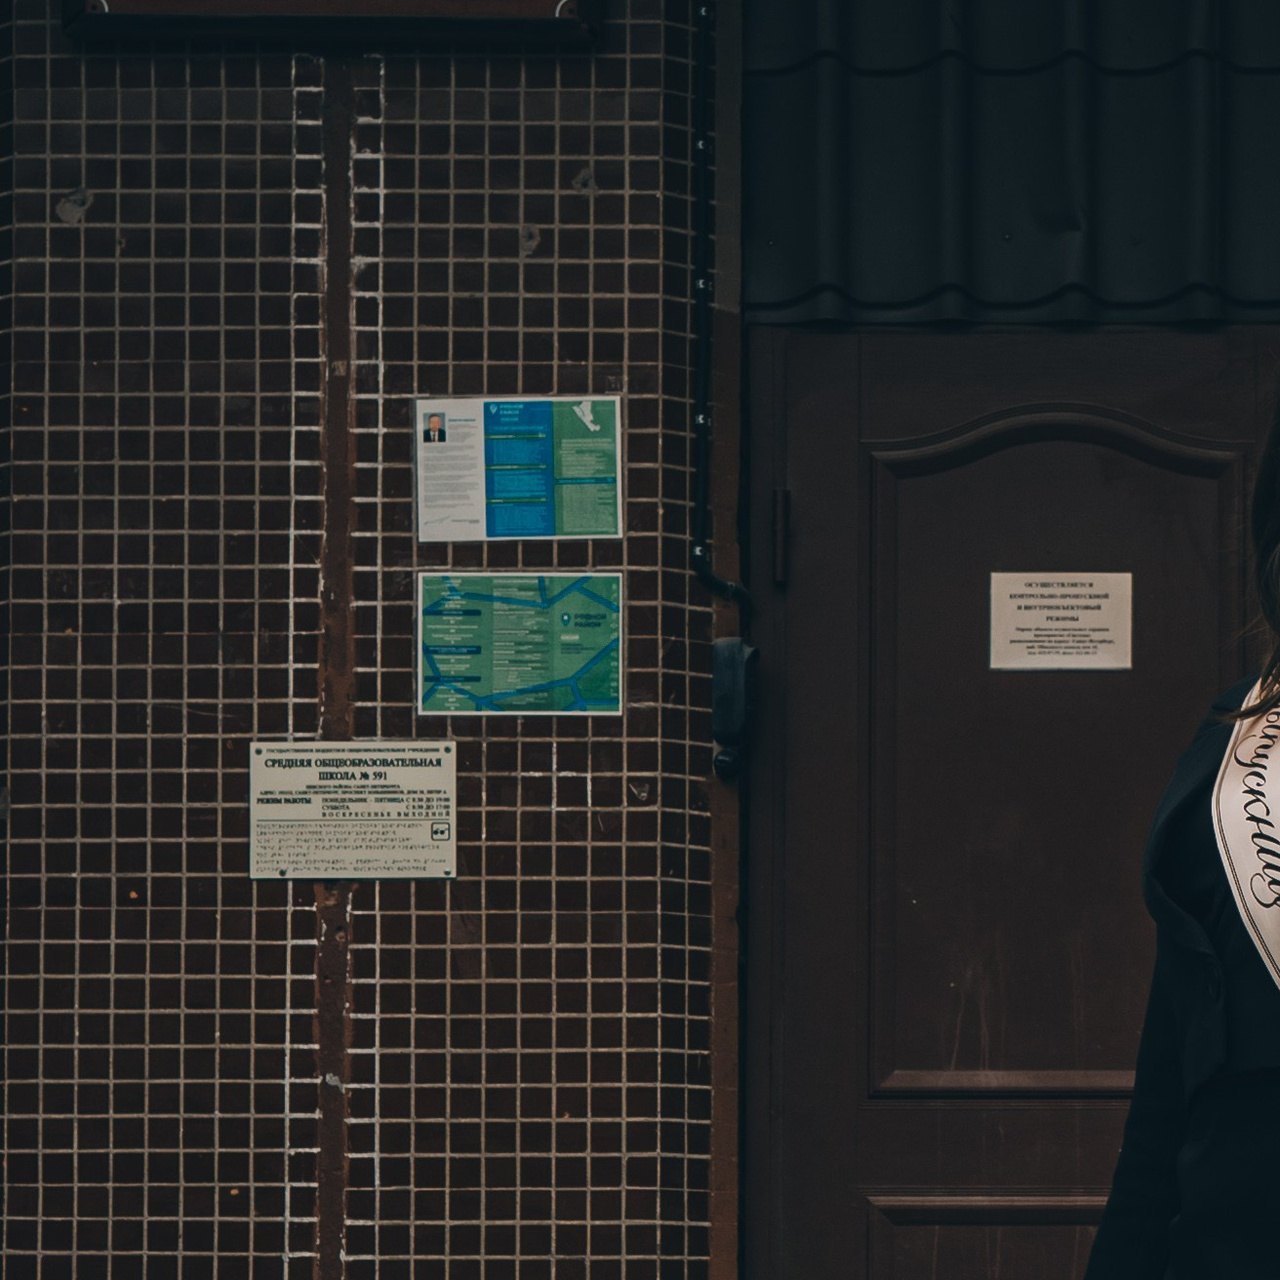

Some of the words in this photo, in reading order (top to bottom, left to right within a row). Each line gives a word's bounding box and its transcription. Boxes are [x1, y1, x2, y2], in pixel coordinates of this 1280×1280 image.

[264, 758, 312, 768] СРЕДНЯЯ
[314, 757, 442, 768] ОБЩЕОБРАЗОВАТЕЛЬНАЯ
[318, 771, 357, 780] ШКОЛА
[372, 771, 387, 780] 591
